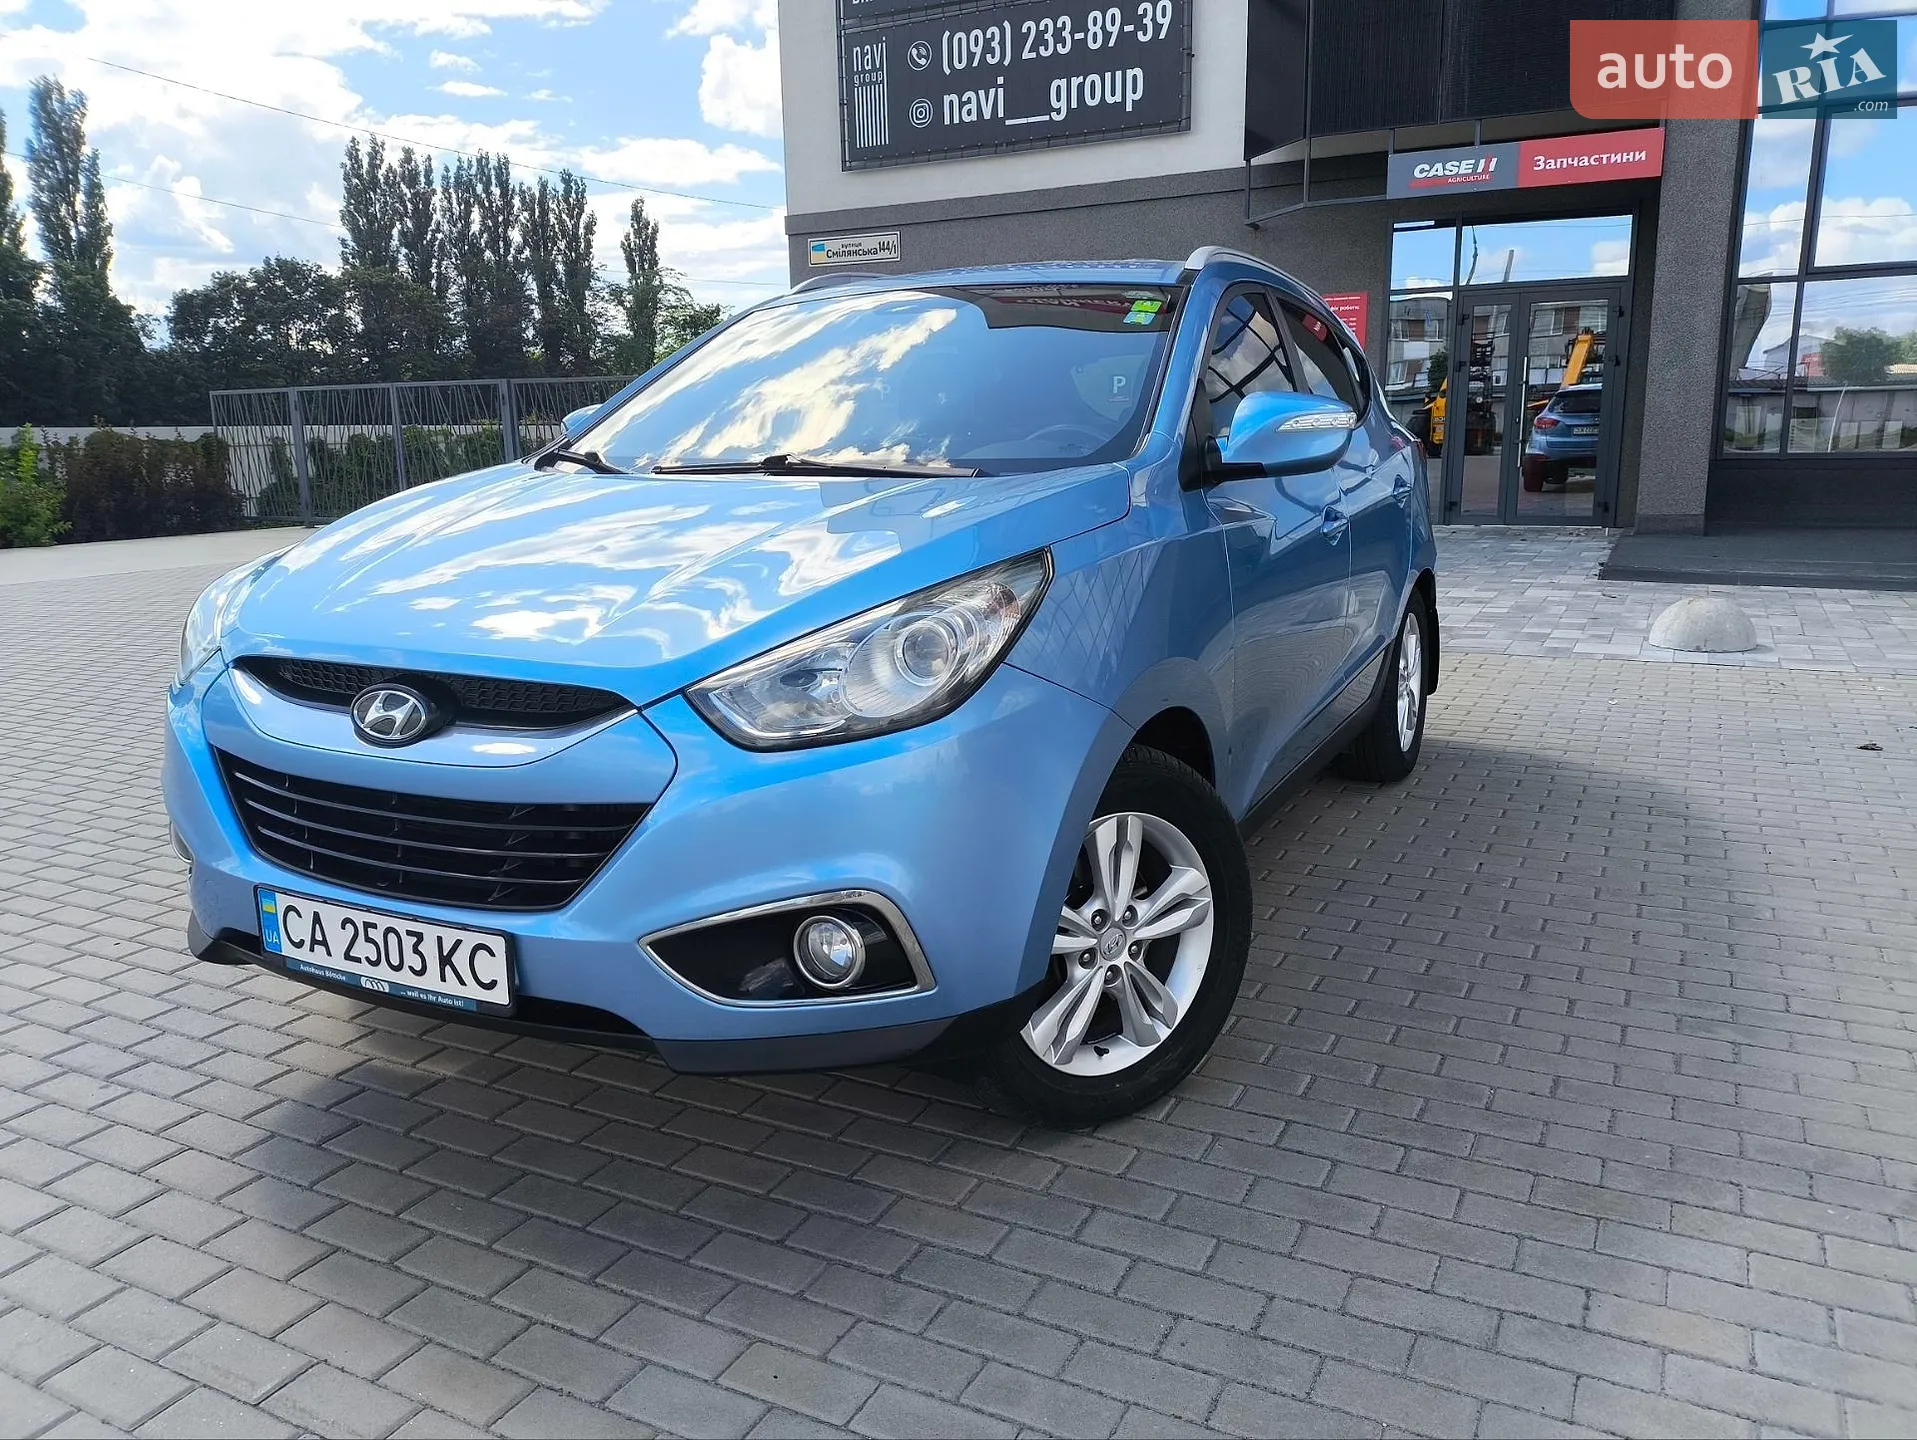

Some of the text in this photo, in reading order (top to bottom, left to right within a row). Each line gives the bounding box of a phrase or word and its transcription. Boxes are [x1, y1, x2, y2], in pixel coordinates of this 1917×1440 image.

[942, 0, 1173, 75] (093) 233-89-39
[853, 36, 887, 72] navi
[854, 71, 884, 87] group
[1413, 157, 1475, 179] CASE
[1533, 150, 1648, 171] Запчастини
[1447, 174, 1490, 184] AGRICULTURE
[826, 240, 897, 259] Смілянська 144/1
[1113, 376, 1127, 394] P
[265, 928, 280, 946] UA
[282, 904, 499, 991] CA 2503 KC
